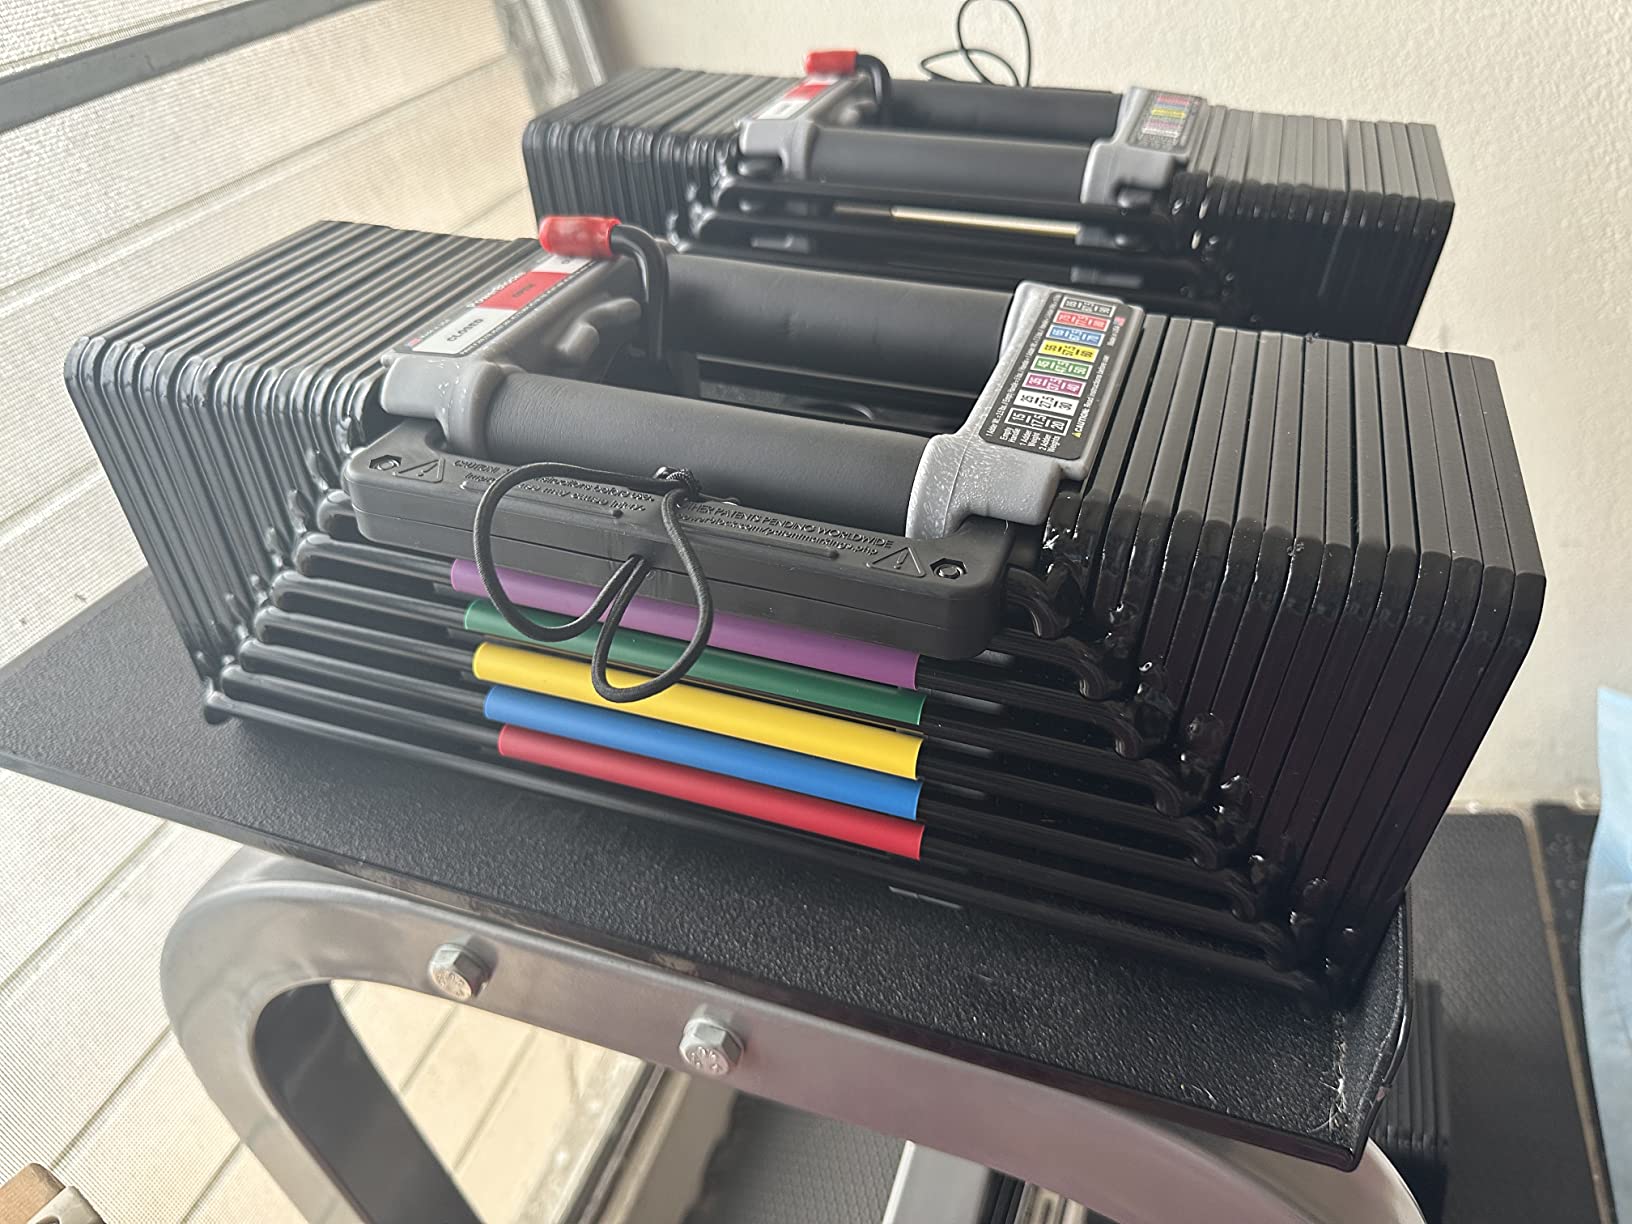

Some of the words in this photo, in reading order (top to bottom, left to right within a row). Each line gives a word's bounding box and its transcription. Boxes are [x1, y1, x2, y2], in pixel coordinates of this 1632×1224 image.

[446, 319, 484, 342] CLOSED
[1062, 345, 1076, 356] 57.5
[1037, 360, 1050, 368] 45
[1054, 361, 1070, 373] 47.5
[1073, 366, 1087, 375] 50
[1029, 376, 1043, 386] 35
[1046, 378, 1063, 391] 37.5
[1088, 375, 1102, 397] instructions
[1020, 394, 1034, 403] 25
[1039, 395, 1055, 409] 27.5
[1059, 402, 1073, 411] 30
[1011, 412, 1026, 422] 15
[1030, 414, 1047, 428] 17.5
[1051, 421, 1065, 430] 20
[1000, 426, 1014, 441] Empty
[1021, 429, 1032, 443] Adder
[1028, 432, 1042, 447] Weight
[1040, 434, 1052, 447] Adder
[1047, 435, 1062, 453] Weights
[541, 487, 571, 498] may
[571, 492, 609, 506] cause
[593, 484, 630, 499] before
[714, 507, 764, 523] PATENTS
[762, 516, 816, 533] PENDING
[817, 527, 896, 549] WORLDWIDE
